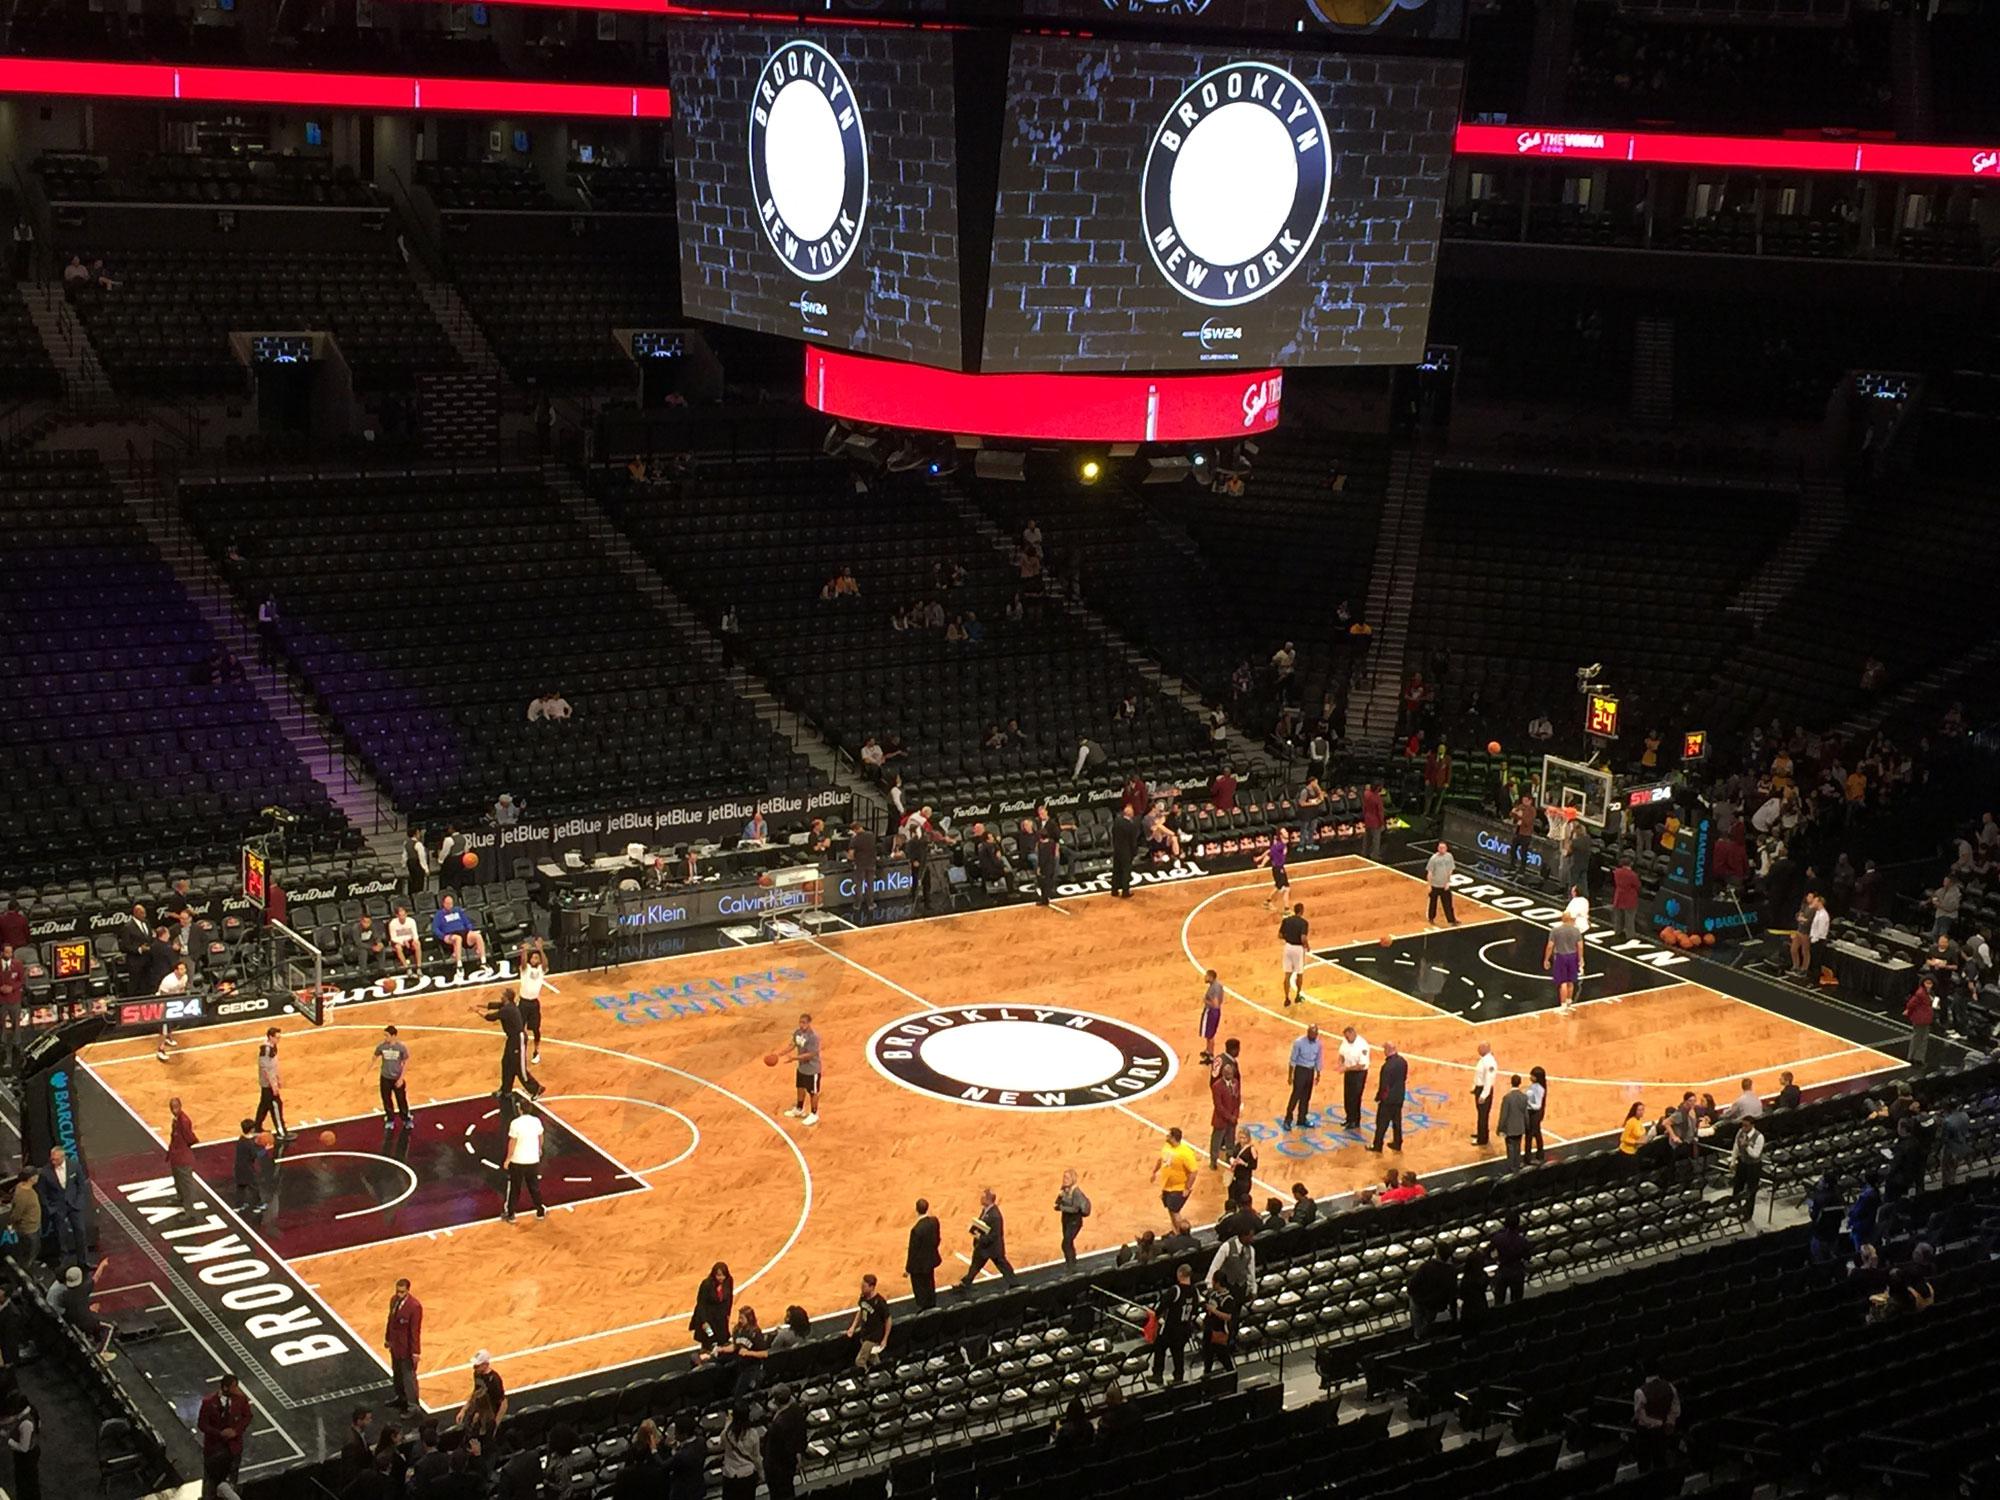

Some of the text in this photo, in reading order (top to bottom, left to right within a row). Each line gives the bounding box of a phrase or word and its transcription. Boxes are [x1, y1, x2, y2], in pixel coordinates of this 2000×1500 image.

[755, 50, 854, 132] BROOKLYN
[1160, 72, 1319, 153] BROOKLYN
[762, 198, 856, 271] NEW YORK
[1154, 226, 1301, 296] NEW YORK
[1202, 327, 1243, 340] SW24
[1592, 710, 1613, 733] 24
[464, 791, 851, 850] Blue jetBlue jetBlue jetBlue jetBlue jetBlue jetBlue jetBlue
[953, 804, 992, 819] FanDuel
[999, 799, 1037, 814] FanDuel
[30, 918, 77, 937] anDuel
[286, 885, 338, 902] FanDuel
[348, 878, 398, 897] FanDuel
[648, 904, 687, 924] Klein
[718, 894, 767, 915] Calvin
[1448, 873, 1691, 967] BROOLYN
[60, 958, 81, 974] 24
[121, 998, 202, 1025] SW24
[217, 998, 269, 1015] GEICO
[883, 1008, 1094, 1060] BROOKLYN
[960, 1055, 1164, 1106] NEW YORK
[117, 1175, 350, 1367] BROOKLYN
